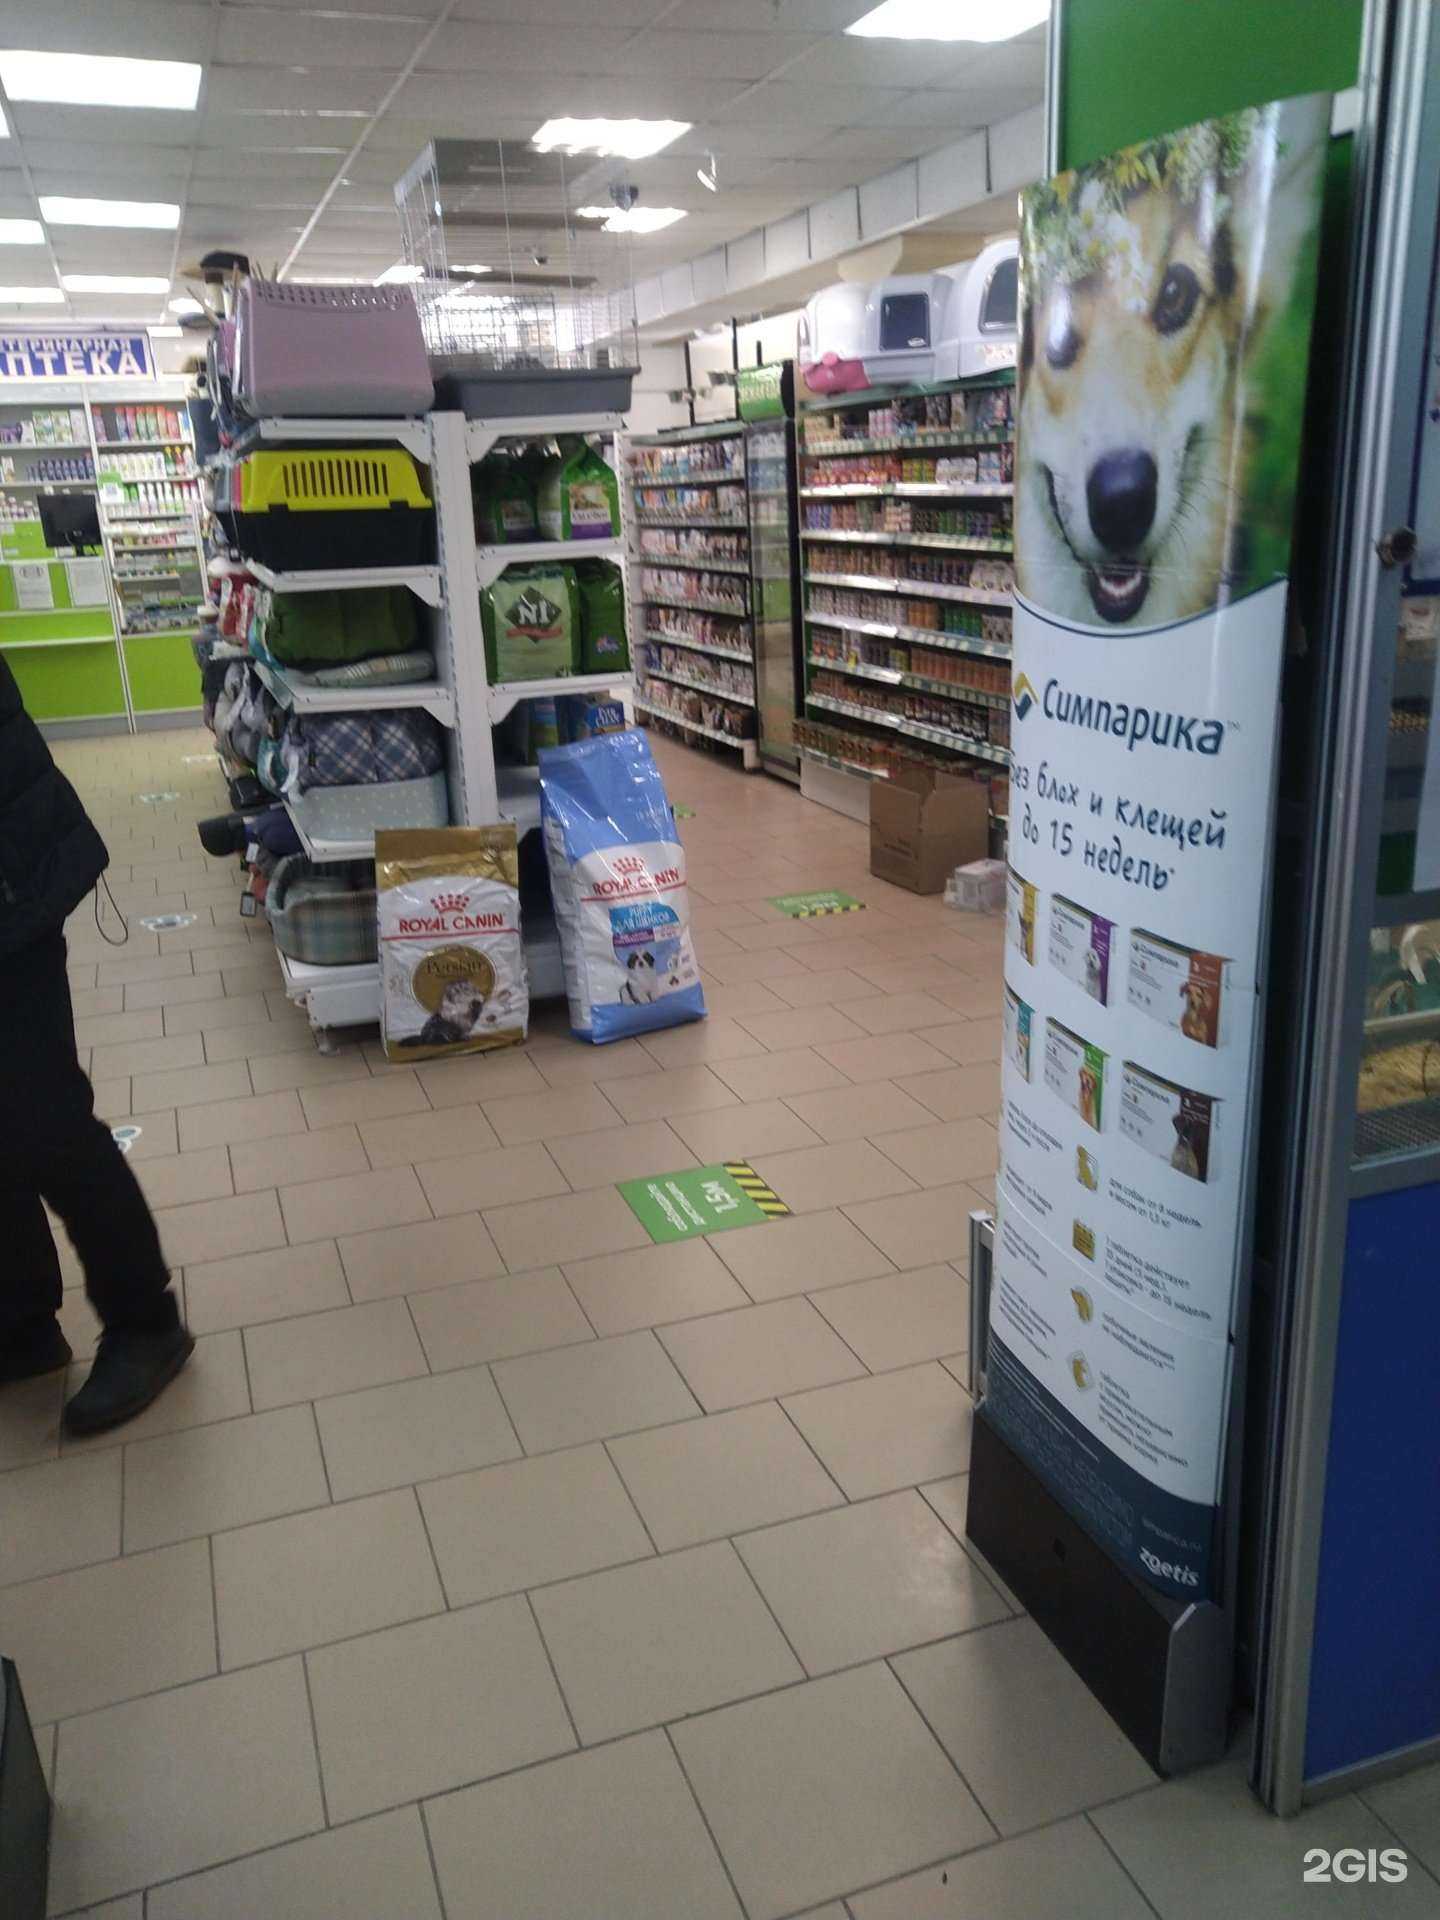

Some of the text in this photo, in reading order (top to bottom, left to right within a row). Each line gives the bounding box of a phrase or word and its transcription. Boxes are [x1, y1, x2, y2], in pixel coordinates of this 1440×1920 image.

[0, 337, 131, 352] ТЕРИНАРНАЯ
[0, 351, 143, 376] ПТЕКА
[1043, 678, 1224, 755] Симпарика
[1012, 761, 1227, 851] ез блох и клещей
[1022, 802, 1039, 845] до
[1050, 819, 1073, 856] 15
[398, 913, 504, 933] ROYAL CANIN
[1139, 1545, 1199, 1587] zoetis
